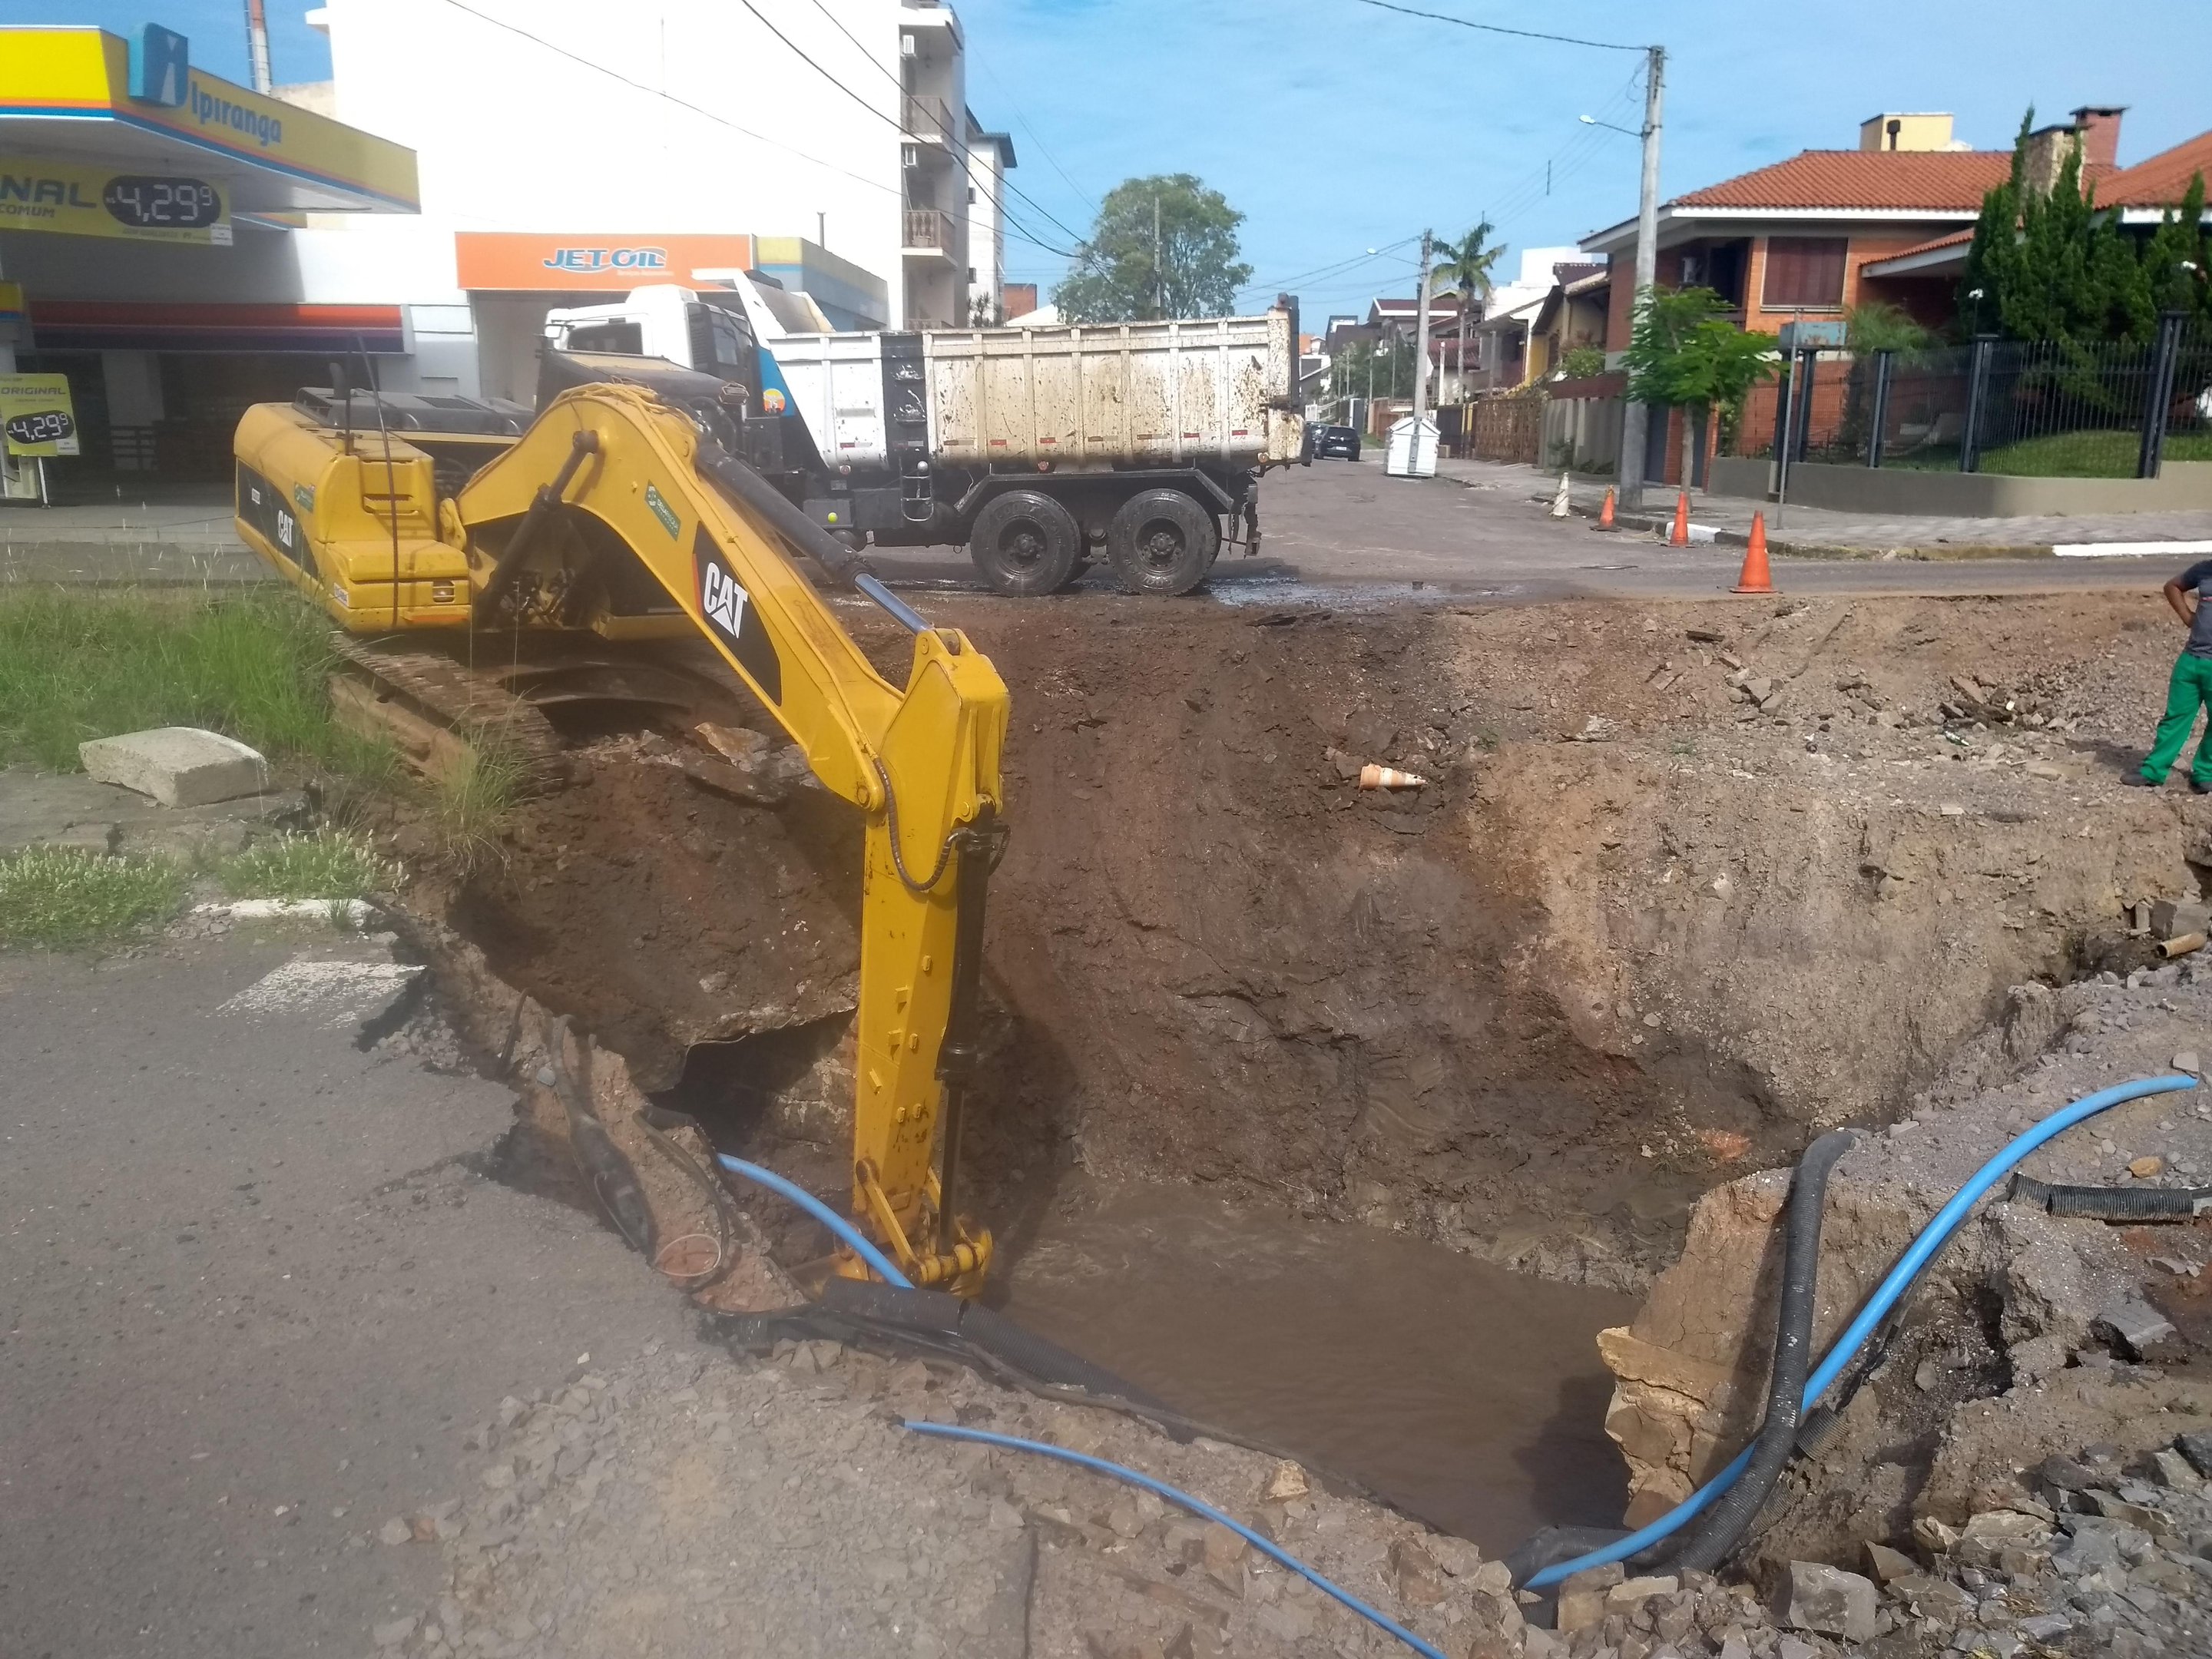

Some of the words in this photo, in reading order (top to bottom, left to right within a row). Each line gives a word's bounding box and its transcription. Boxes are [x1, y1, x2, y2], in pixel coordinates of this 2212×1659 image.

[191, 80, 282, 147] Ipiranga
[543, 248, 608, 268] JET
[611, 247, 666, 268] OIL
[1, 386, 67, 395] ORIGINAL
[278, 509, 293, 548] CAT
[704, 561, 749, 639] CAT
